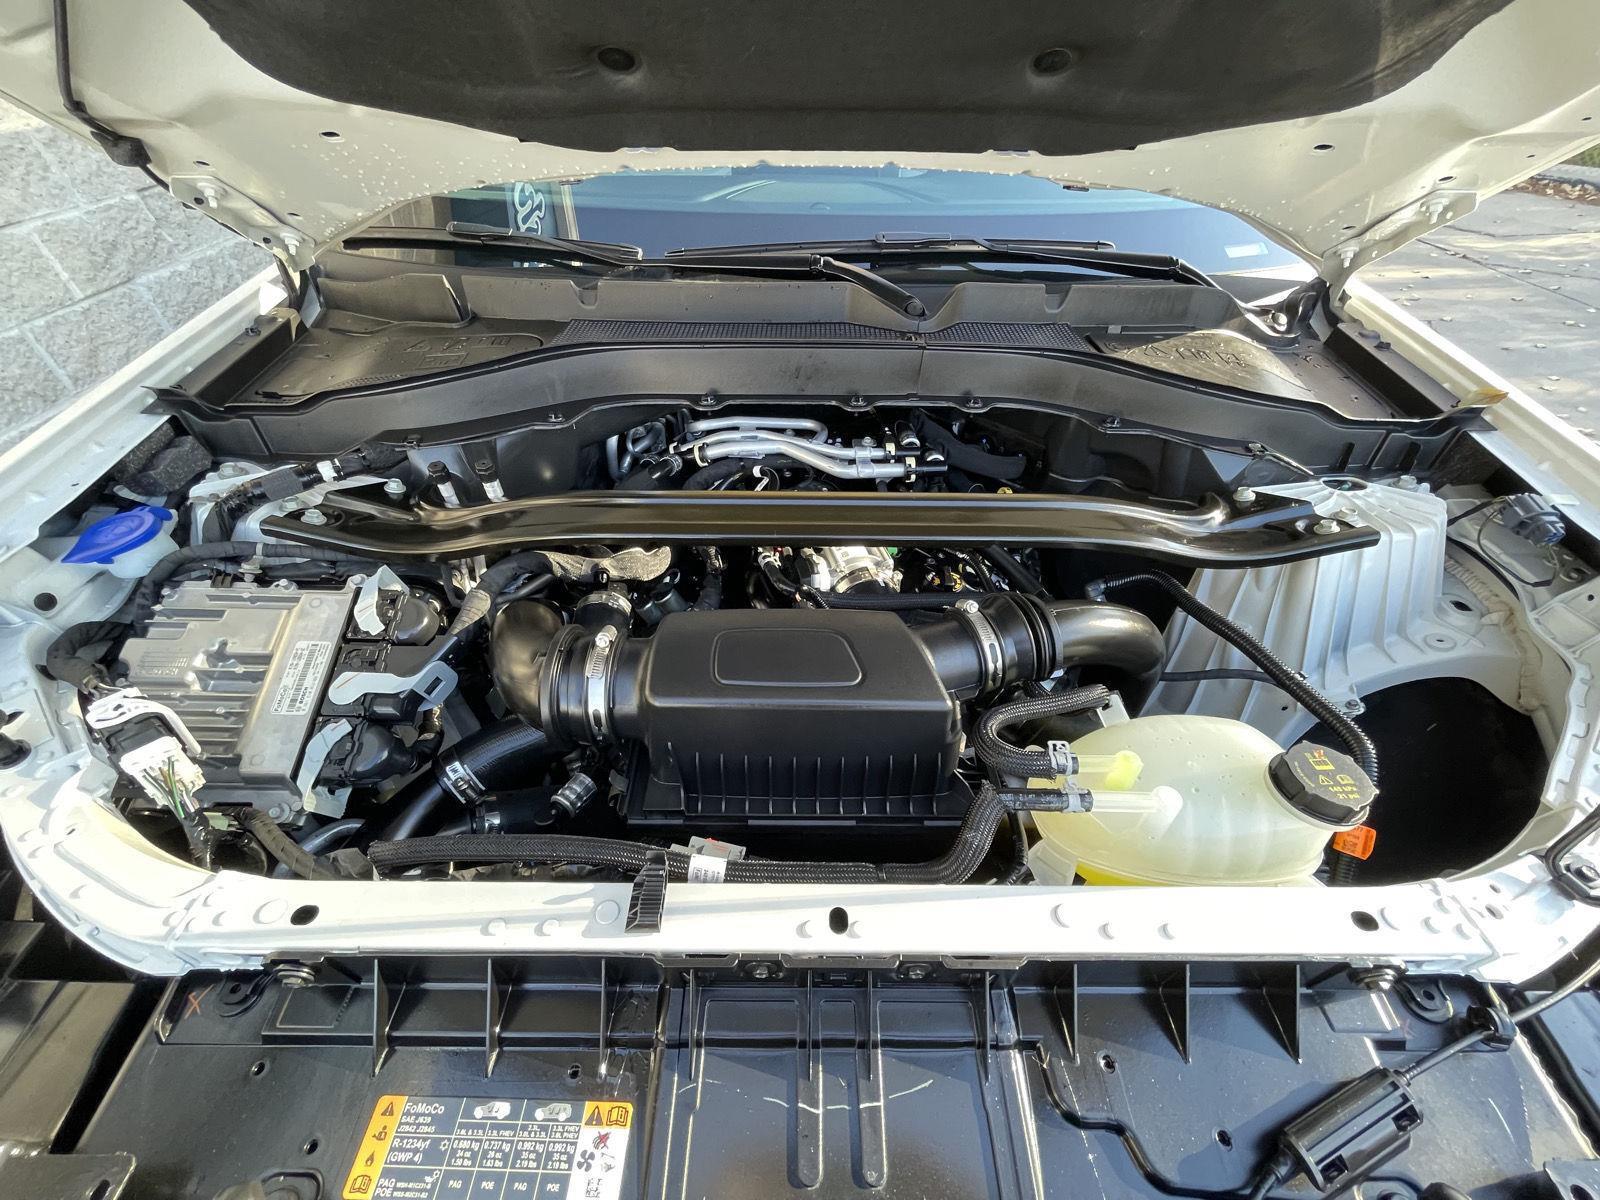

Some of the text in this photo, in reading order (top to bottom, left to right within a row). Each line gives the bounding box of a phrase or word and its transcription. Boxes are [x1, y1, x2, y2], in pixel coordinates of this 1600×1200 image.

[299, 686, 309, 704] BOSCH
[404, 1103, 444, 1114] FoMoCo
[392, 1139, 431, 1150] R-1234yf
[472, 1140, 480, 1151] kg
[484, 1141, 511, 1151] 0.737 kg
[535, 1142, 544, 1152] kg
[566, 1143, 576, 1153] kg
[387, 1152, 423, 1164] (GWP 4)
[553, 1152, 560, 1160] 35
[378, 1179, 396, 1188] PAG
[448, 1180, 462, 1189] PAG
[481, 1181, 495, 1190] POE
[513, 1182, 527, 1191] PAG
[547, 1183, 560, 1192] POE
[374, 1187, 393, 1197] POE
